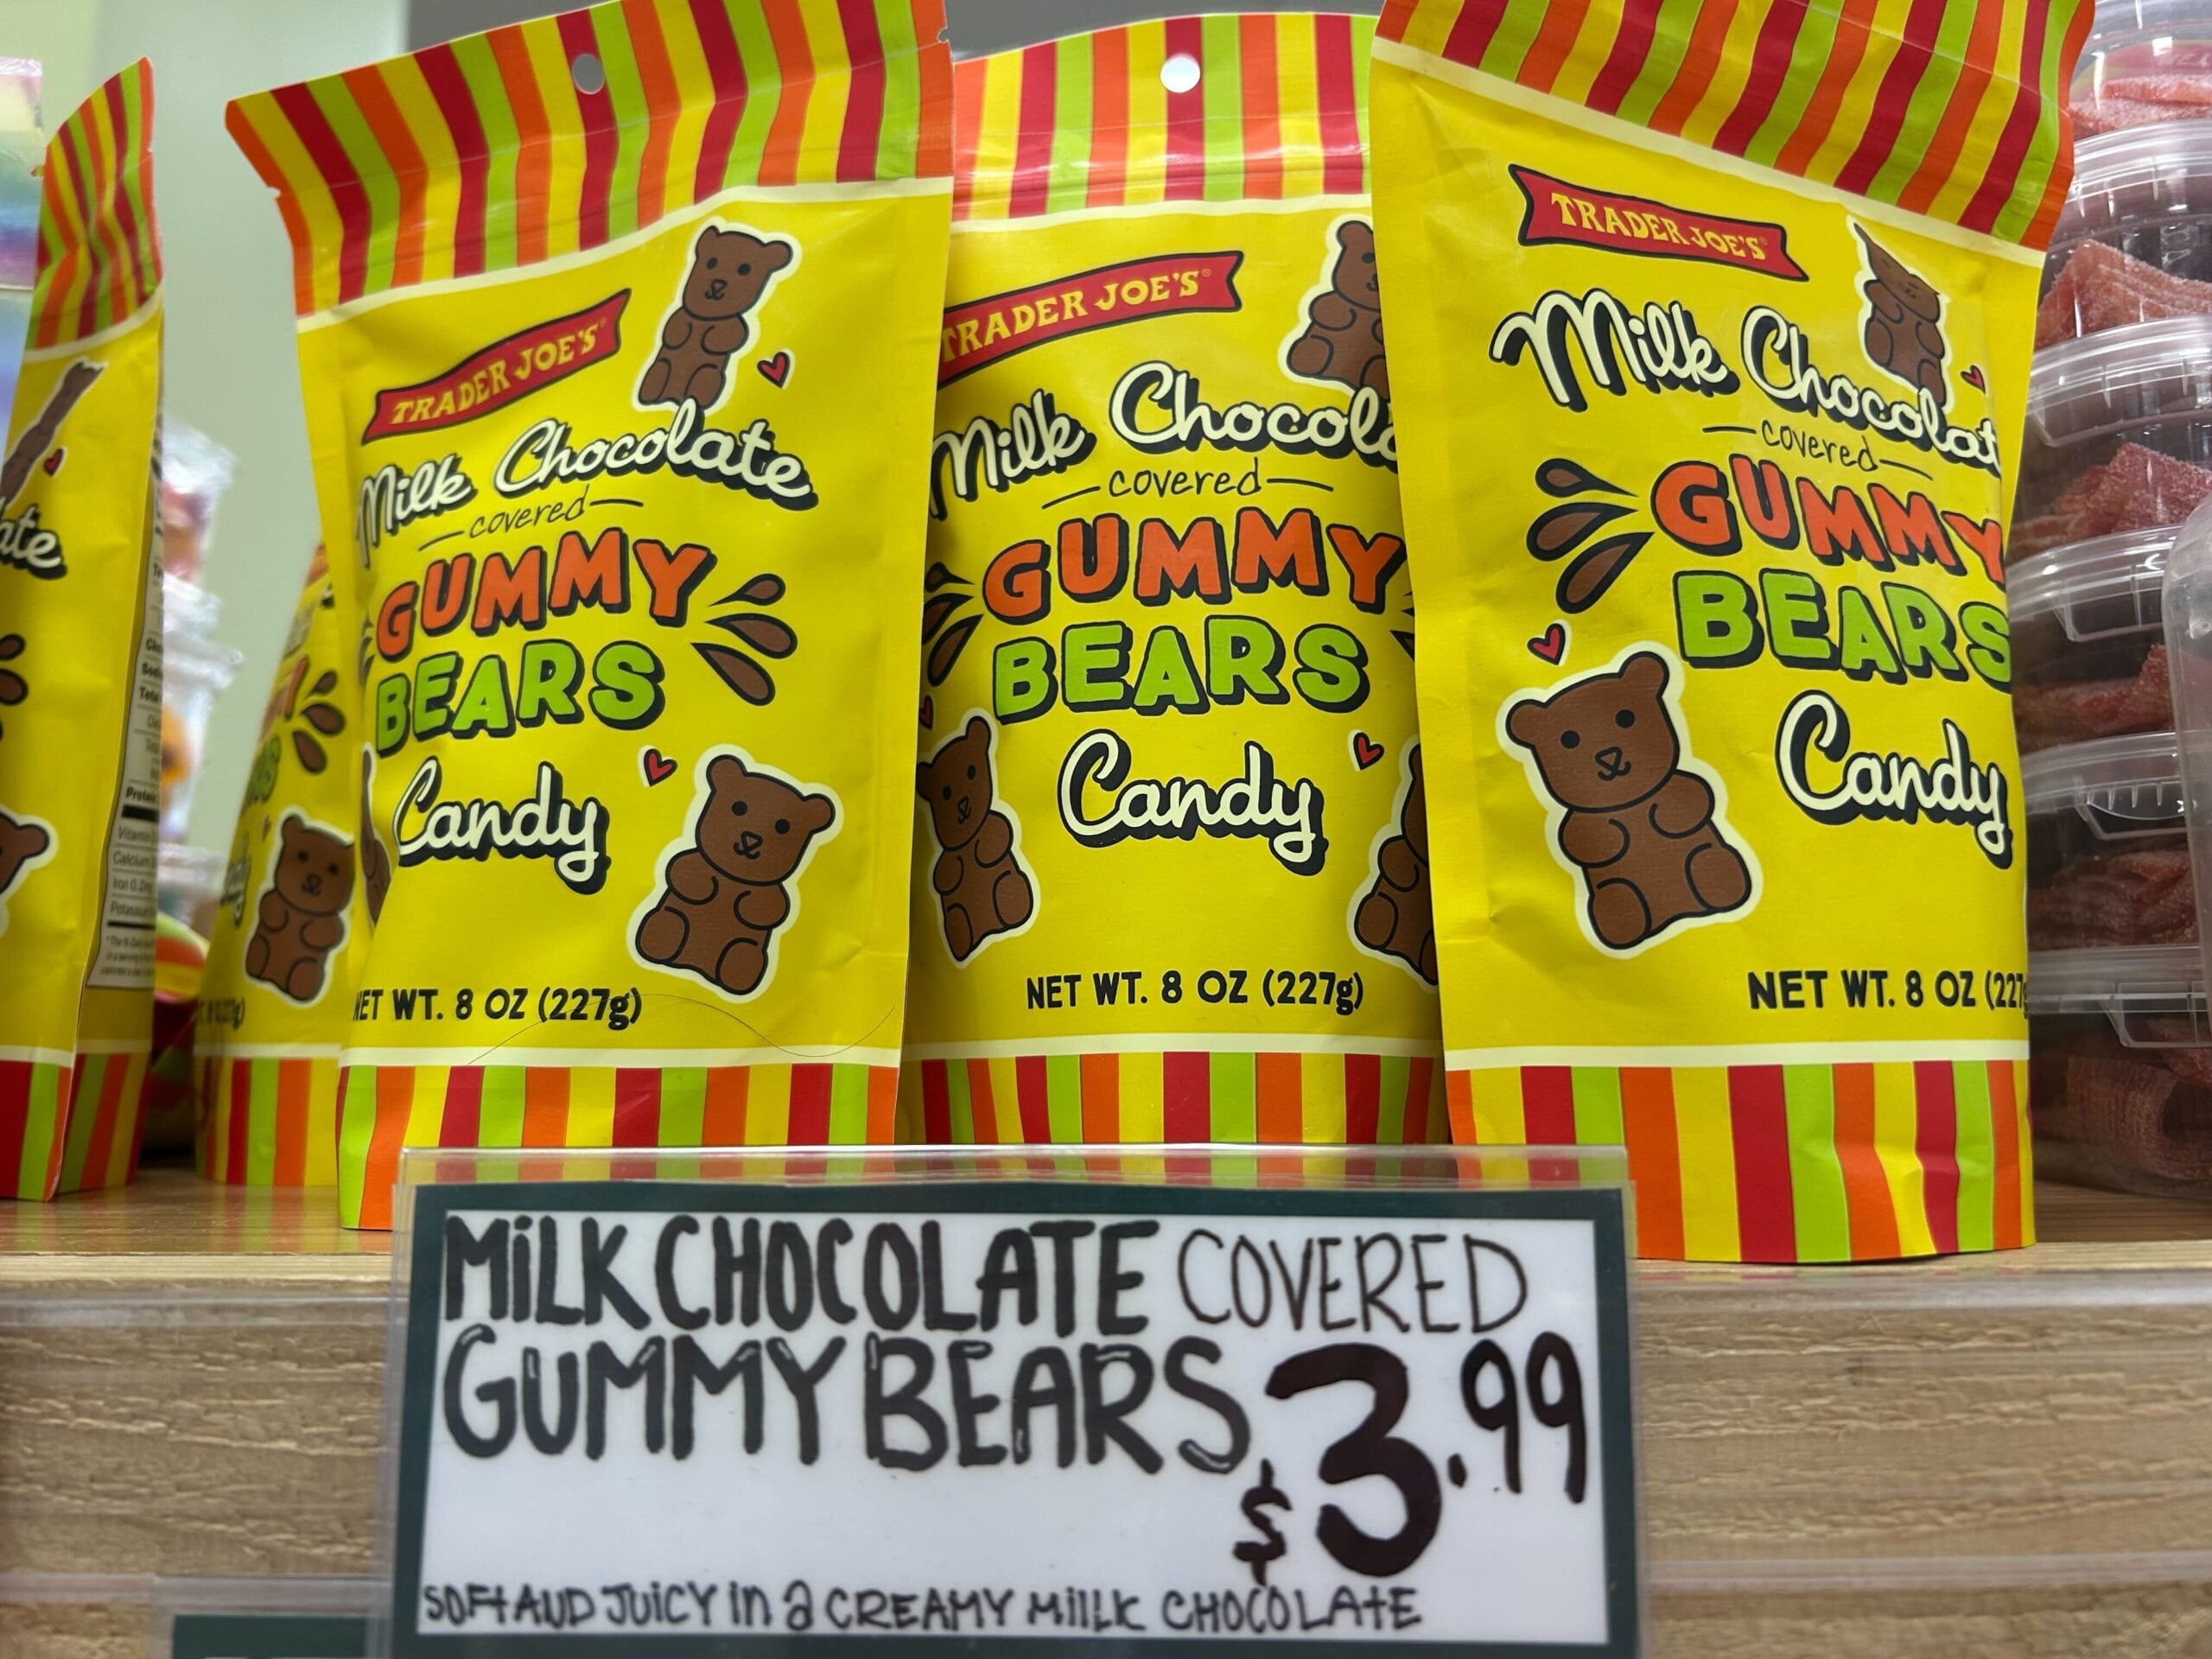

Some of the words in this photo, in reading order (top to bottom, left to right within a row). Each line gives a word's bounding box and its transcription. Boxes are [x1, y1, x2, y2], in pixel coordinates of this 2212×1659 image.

[1551, 193, 1690, 245] TRADER
[1689, 226, 1765, 260] JOE'S
[389, 360, 510, 424] TRADER
[514, 322, 599, 380] JOE'S
[940, 289, 1088, 363] TRADER
[1094, 270, 1199, 311] JOE'S
[1490, 288, 1740, 411] Milk
[356, 453, 478, 570] Milk
[493, 397, 818, 511] Chocolate
[929, 388, 1097, 521] Milk
[1109, 457, 1264, 498] covered
[1761, 419, 1878, 472] covered
[469, 484, 586, 540] covered
[982, 507, 1407, 623] GUMMY
[1651, 453, 2005, 592] GUMMY
[375, 526, 718, 663] GUMMY
[1673, 568, 2012, 694] BEARS
[375, 639, 665, 757] BEARS
[992, 614, 1370, 725] BEARS
[394, 756, 611, 894] Candy
[1058, 729, 1329, 876] Candy
[1776, 690, 2013, 869] Candy
[392, 988, 443, 1020] WT.
[455, 988, 474, 1020] 8
[485, 988, 528, 1020] OZ
[538, 986, 642, 1031] (227g)
[1026, 975, 1082, 1009] NET
[1093, 972, 1147, 1005] WT.
[1161, 970, 1183, 1004] 8
[1198, 970, 1249, 1004] OZ
[1262, 969, 1363, 1015] (227g)
[1747, 970, 1827, 1009] NET
[1840, 969, 1895, 1007] WT.
[1904, 969, 1924, 1007] 8
[1935, 970, 1976, 1007] OZ
[445, 1215, 651, 1331] MiLK
[656, 1214, 1160, 1338] CHOCOLATE
[1178, 1228, 1528, 1334] COVERED
[444, 1324, 846, 1465] GUMMY
[864, 1331, 1251, 1475] BEARS
[1233, 1331, 1587, 1586] $3.99
[825, 1586, 1014, 1632] CREAMY
